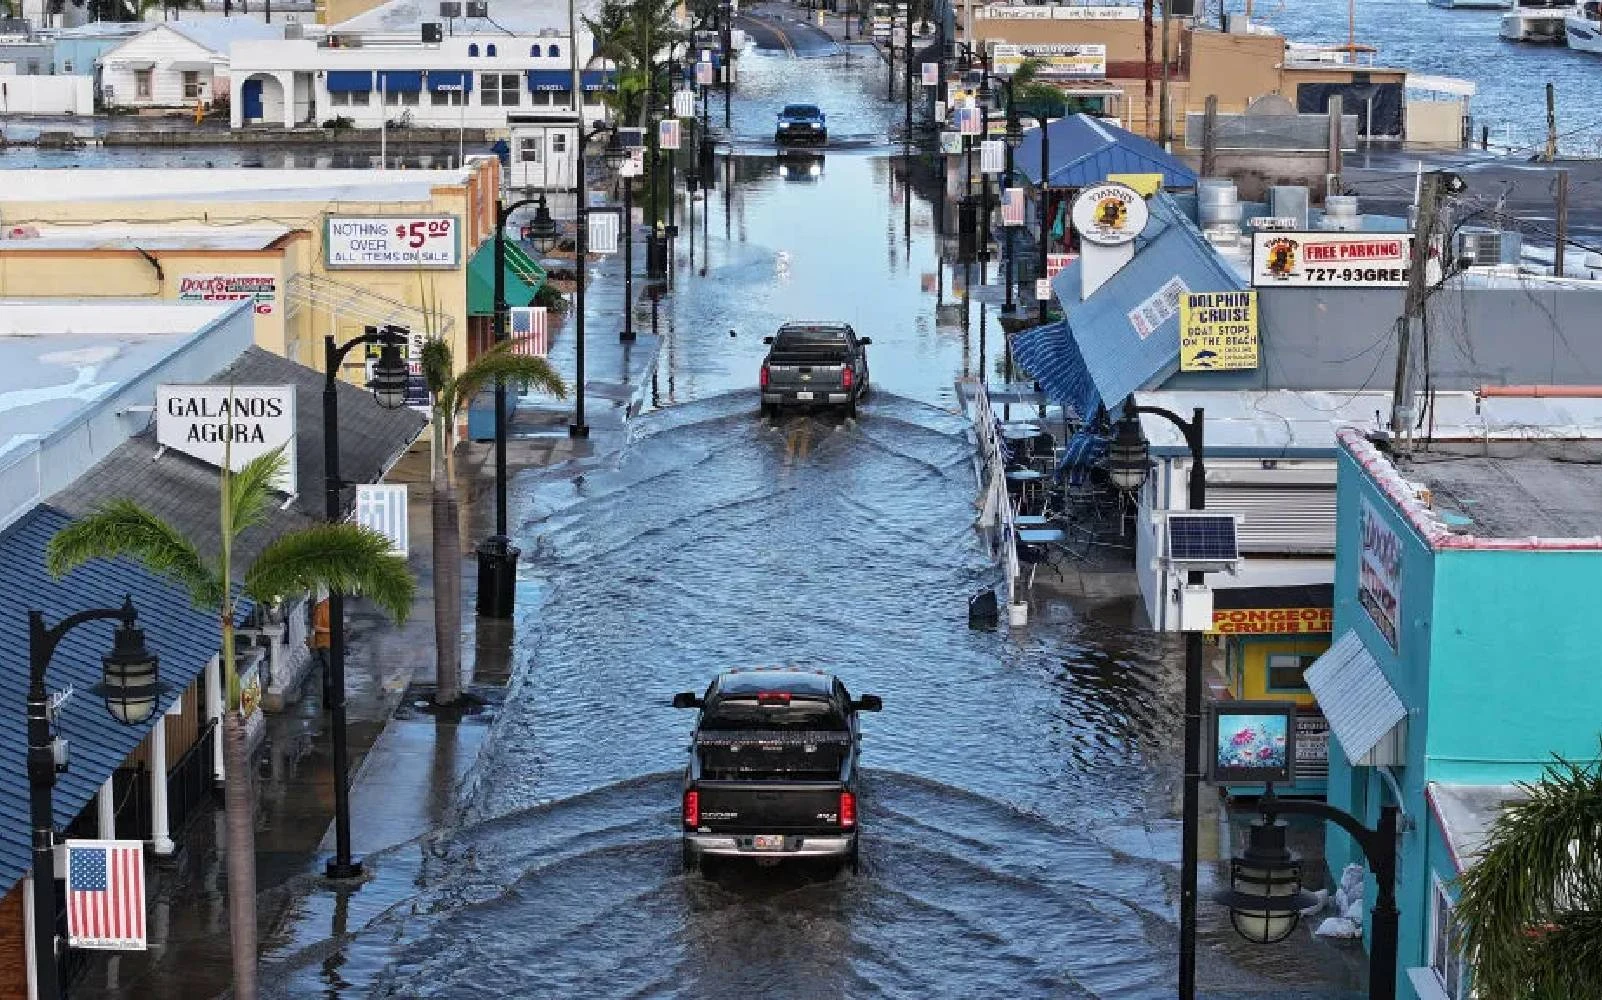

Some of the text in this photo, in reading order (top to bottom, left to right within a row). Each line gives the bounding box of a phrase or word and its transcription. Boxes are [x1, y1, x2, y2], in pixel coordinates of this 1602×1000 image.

[333, 223, 388, 236] NOTHING
[350, 239, 387, 250] OVER
[335, 252, 449, 260] ALL ITEMS ON SALE
[1307, 243, 1397, 259] FREE PARKING
[1305, 269, 1411, 281] 727-93GREE
[1189, 293, 1250, 308] DOLPHIN
[1200, 308, 1250, 323] CRUISE
[1218, 326, 1250, 336] STOPS
[1203, 337, 1221, 346] THE
[168, 397, 283, 418] GALANOS
[187, 423, 265, 443] AGORA
[1219, 622, 1300, 632] CRUISE
